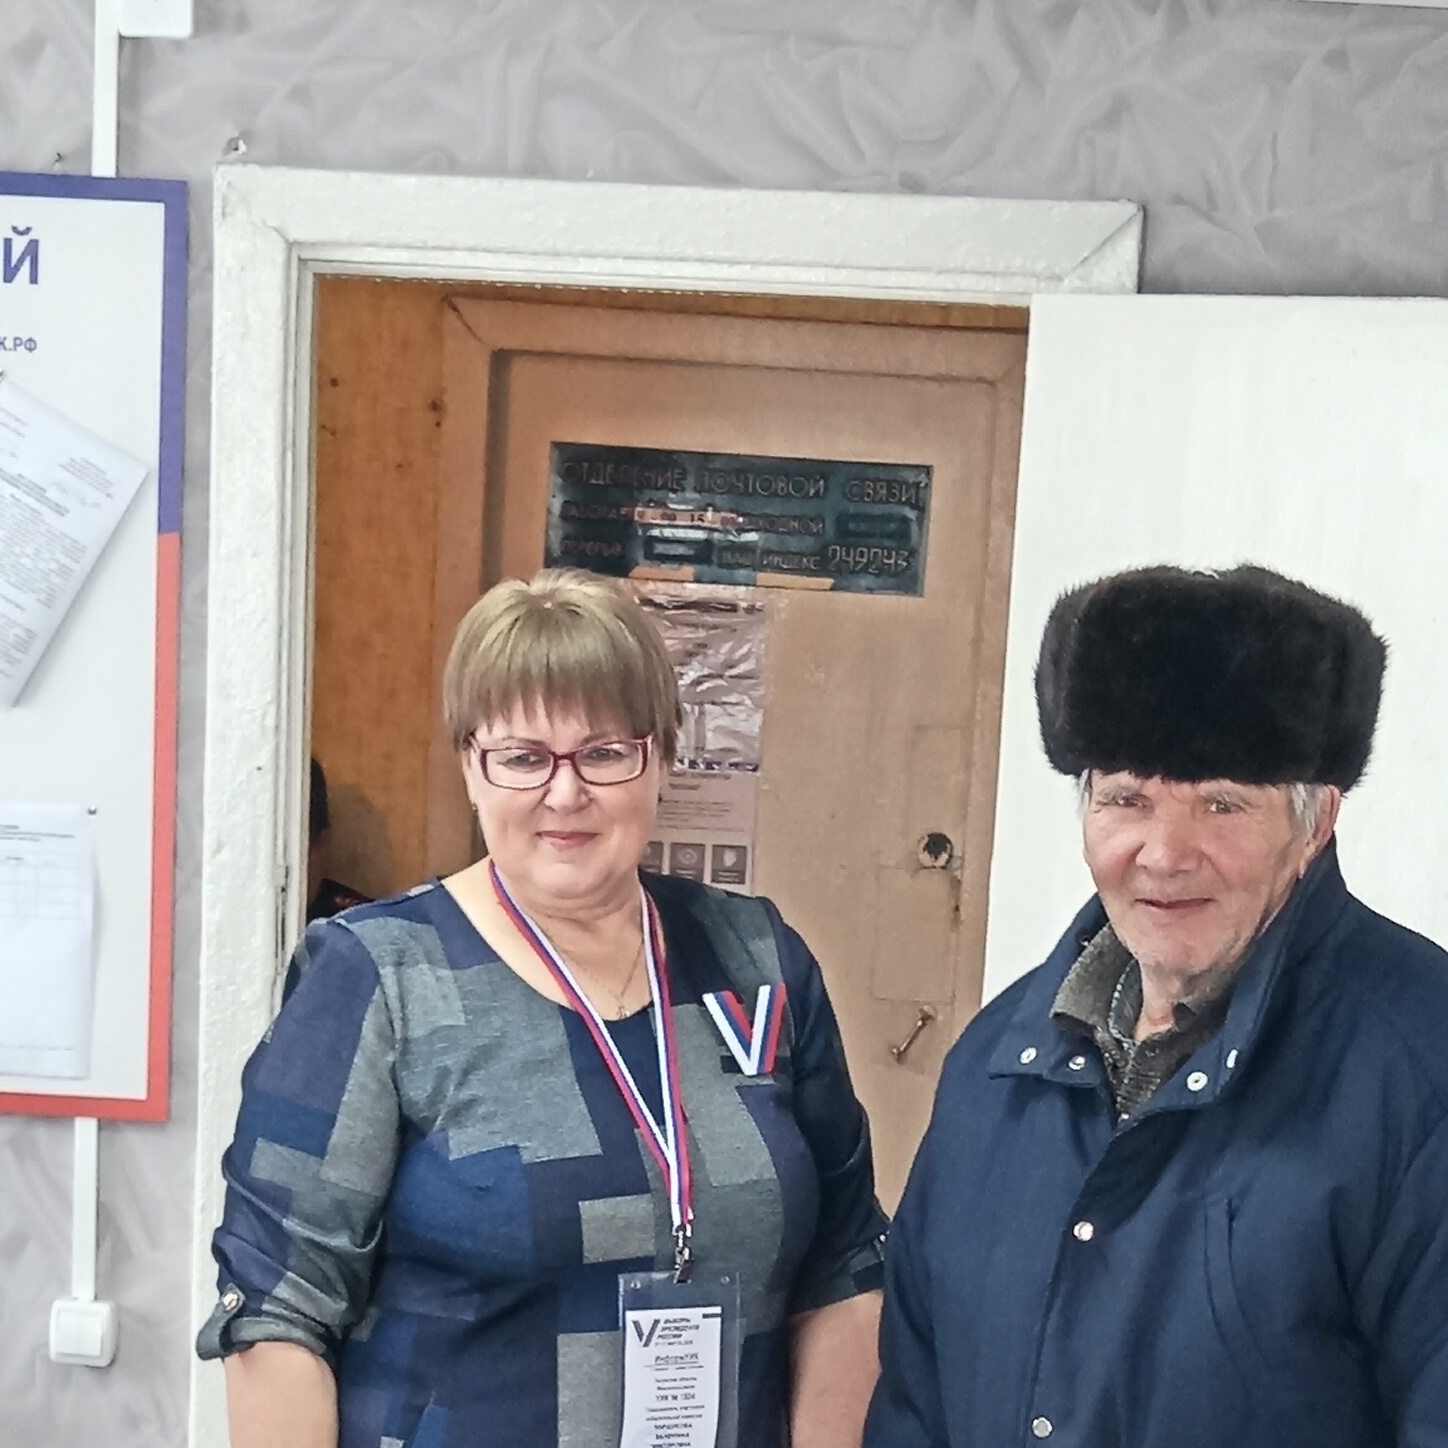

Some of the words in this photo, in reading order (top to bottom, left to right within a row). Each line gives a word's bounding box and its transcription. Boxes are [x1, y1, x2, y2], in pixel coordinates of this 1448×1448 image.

[698, 469, 825, 498] ПОЧТОВОЙ
[846, 479, 918, 504] СВЯЗИ
[827, 544, 910, 575] 249243
